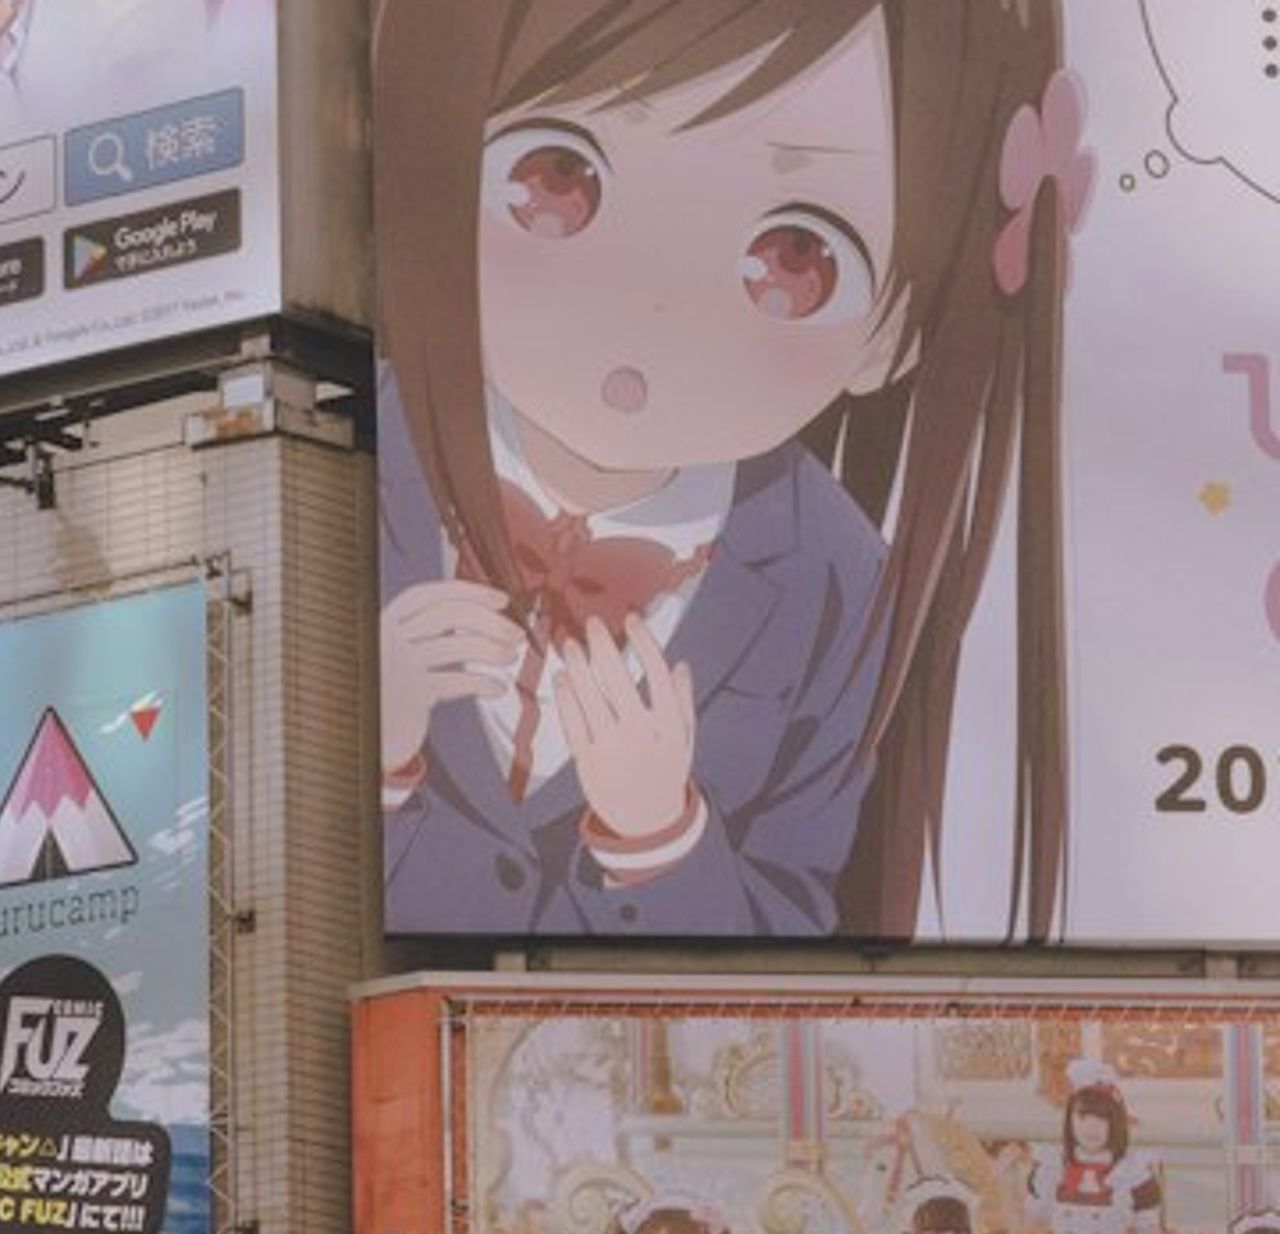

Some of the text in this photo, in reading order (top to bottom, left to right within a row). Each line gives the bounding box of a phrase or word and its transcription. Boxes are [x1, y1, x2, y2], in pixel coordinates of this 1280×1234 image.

[146, 115, 223, 171] 検索
[113, 208, 219, 251] Google Play
[1153, 744, 1280, 814] 20
